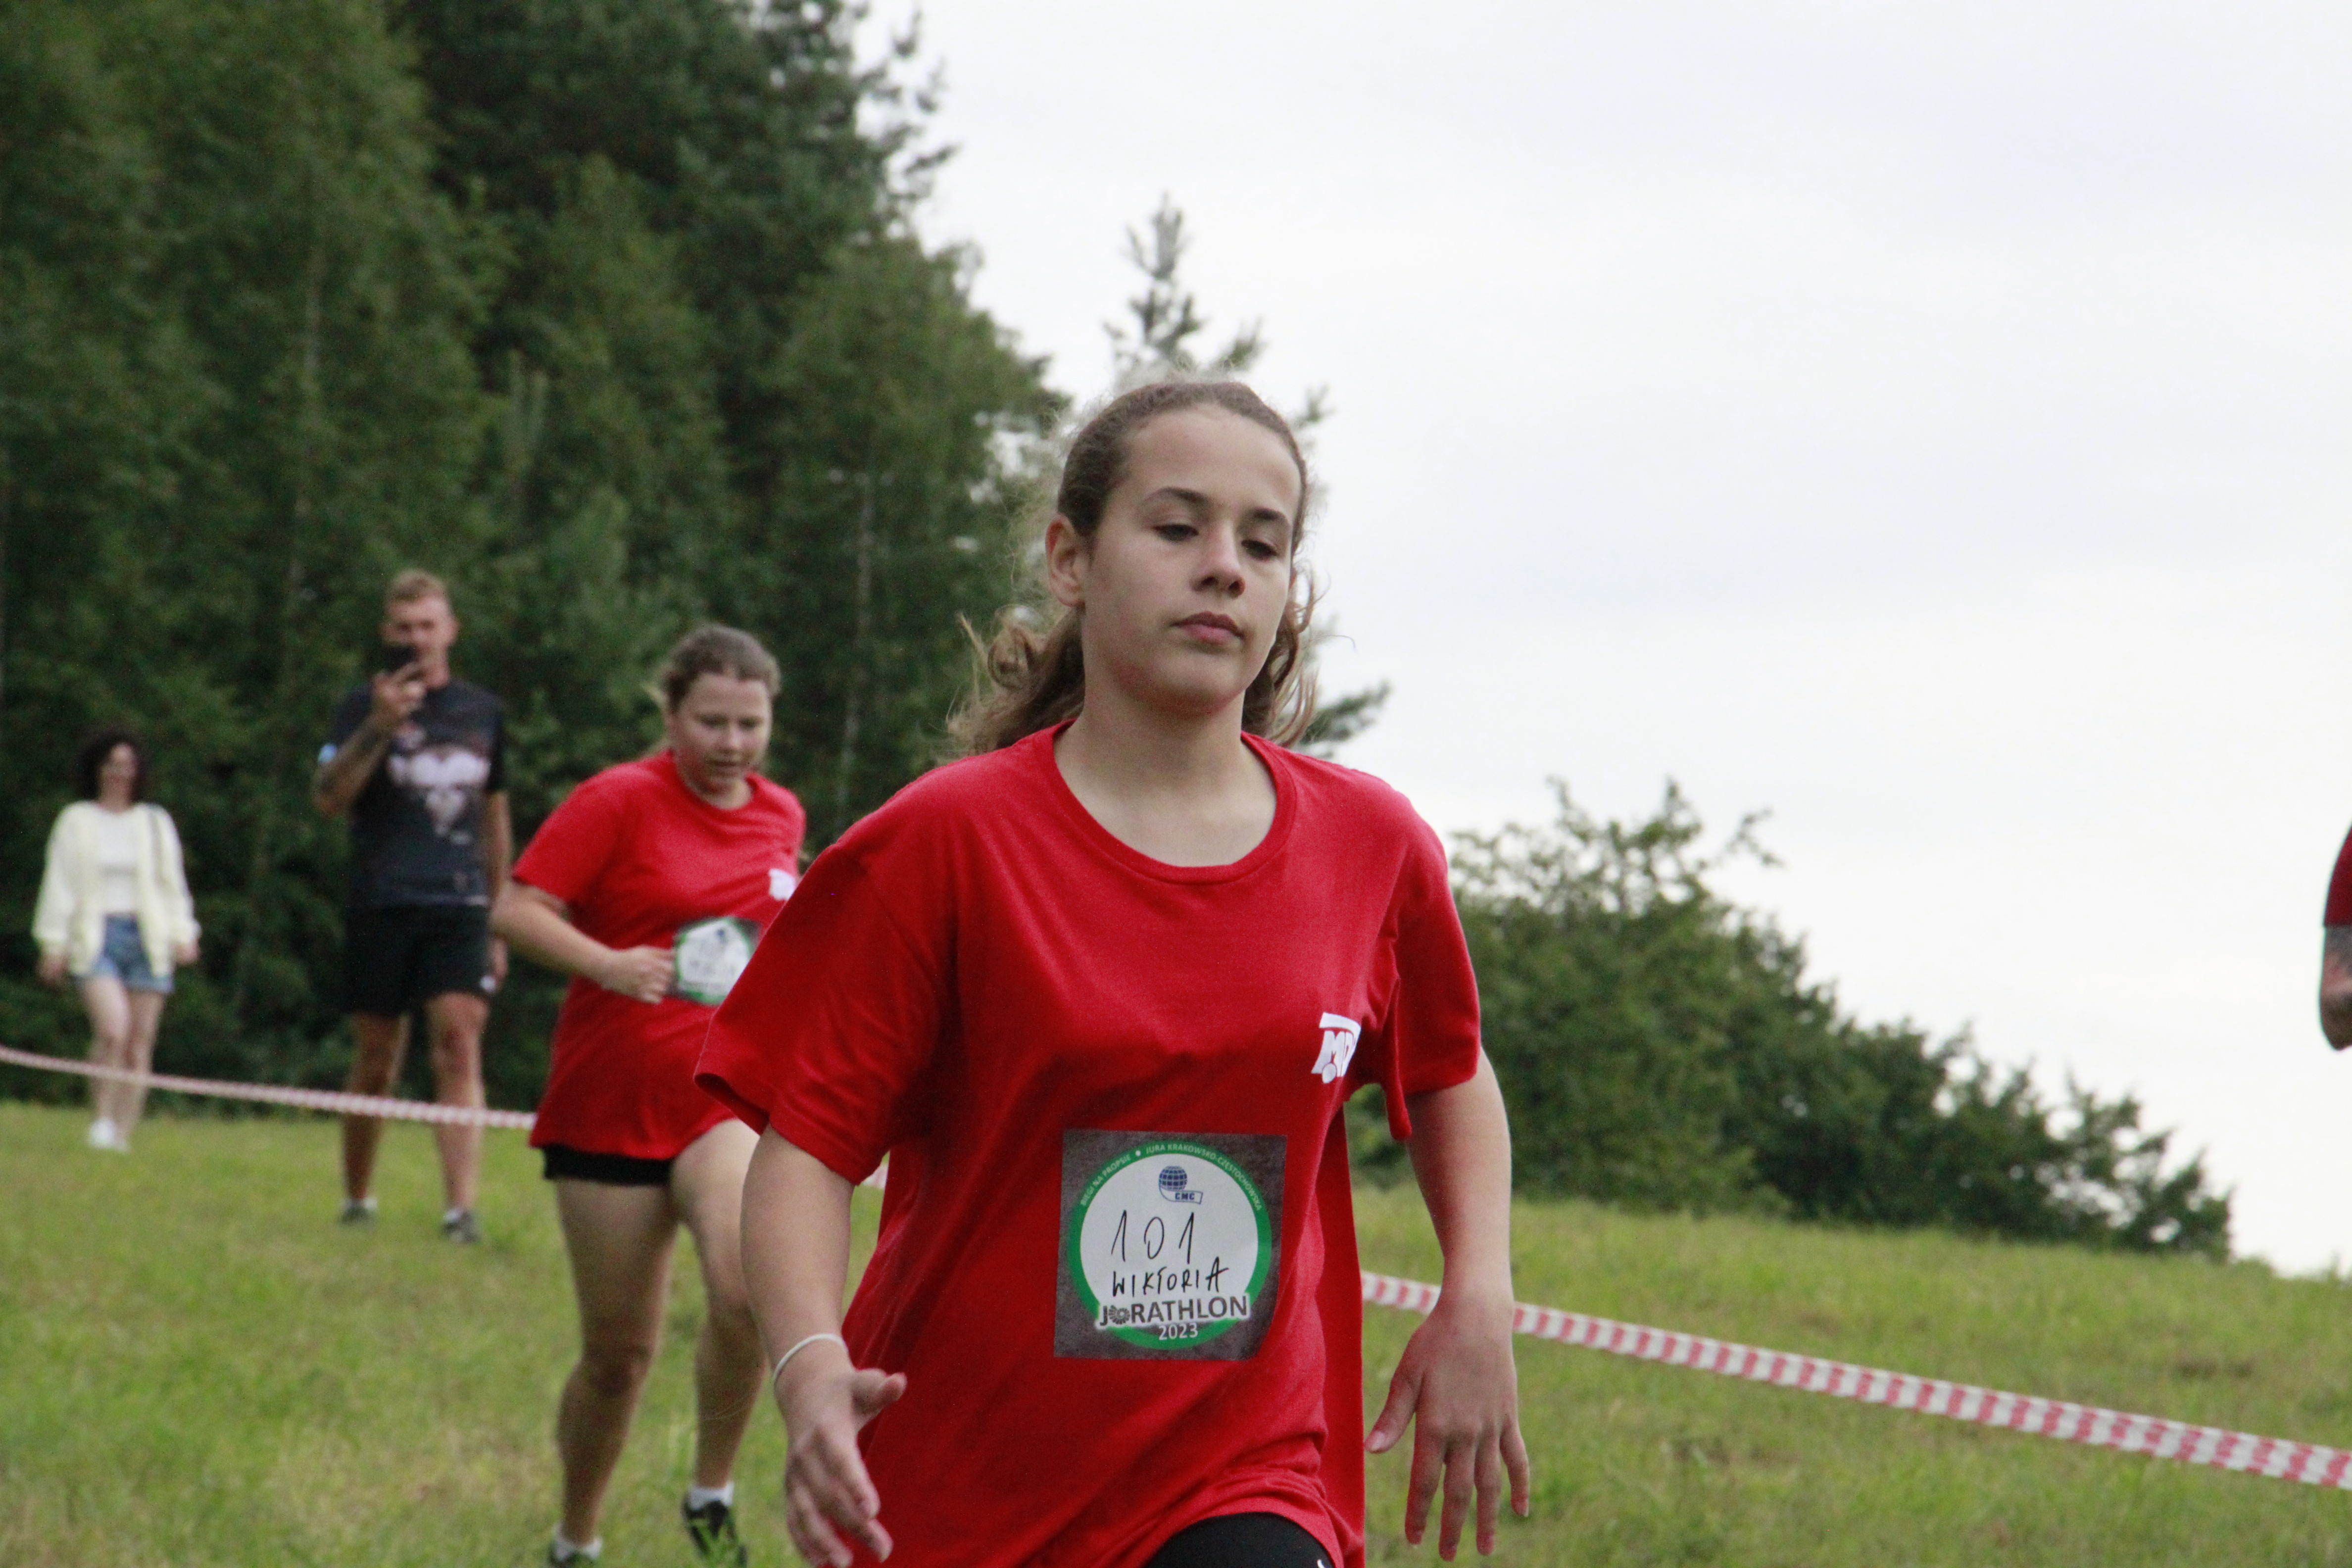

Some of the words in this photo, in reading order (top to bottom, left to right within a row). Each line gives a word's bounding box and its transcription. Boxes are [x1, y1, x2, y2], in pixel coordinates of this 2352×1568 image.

[1146, 1144, 1166, 1154] JURA
[1092, 1175, 1104, 1188] NA
[1102, 1154, 1131, 1177] PROPSIE
[1111, 1210, 1194, 1265] 101
[1112, 1256, 1229, 1297] WIKTORIA
[1158, 1322, 1198, 1340] 2023
